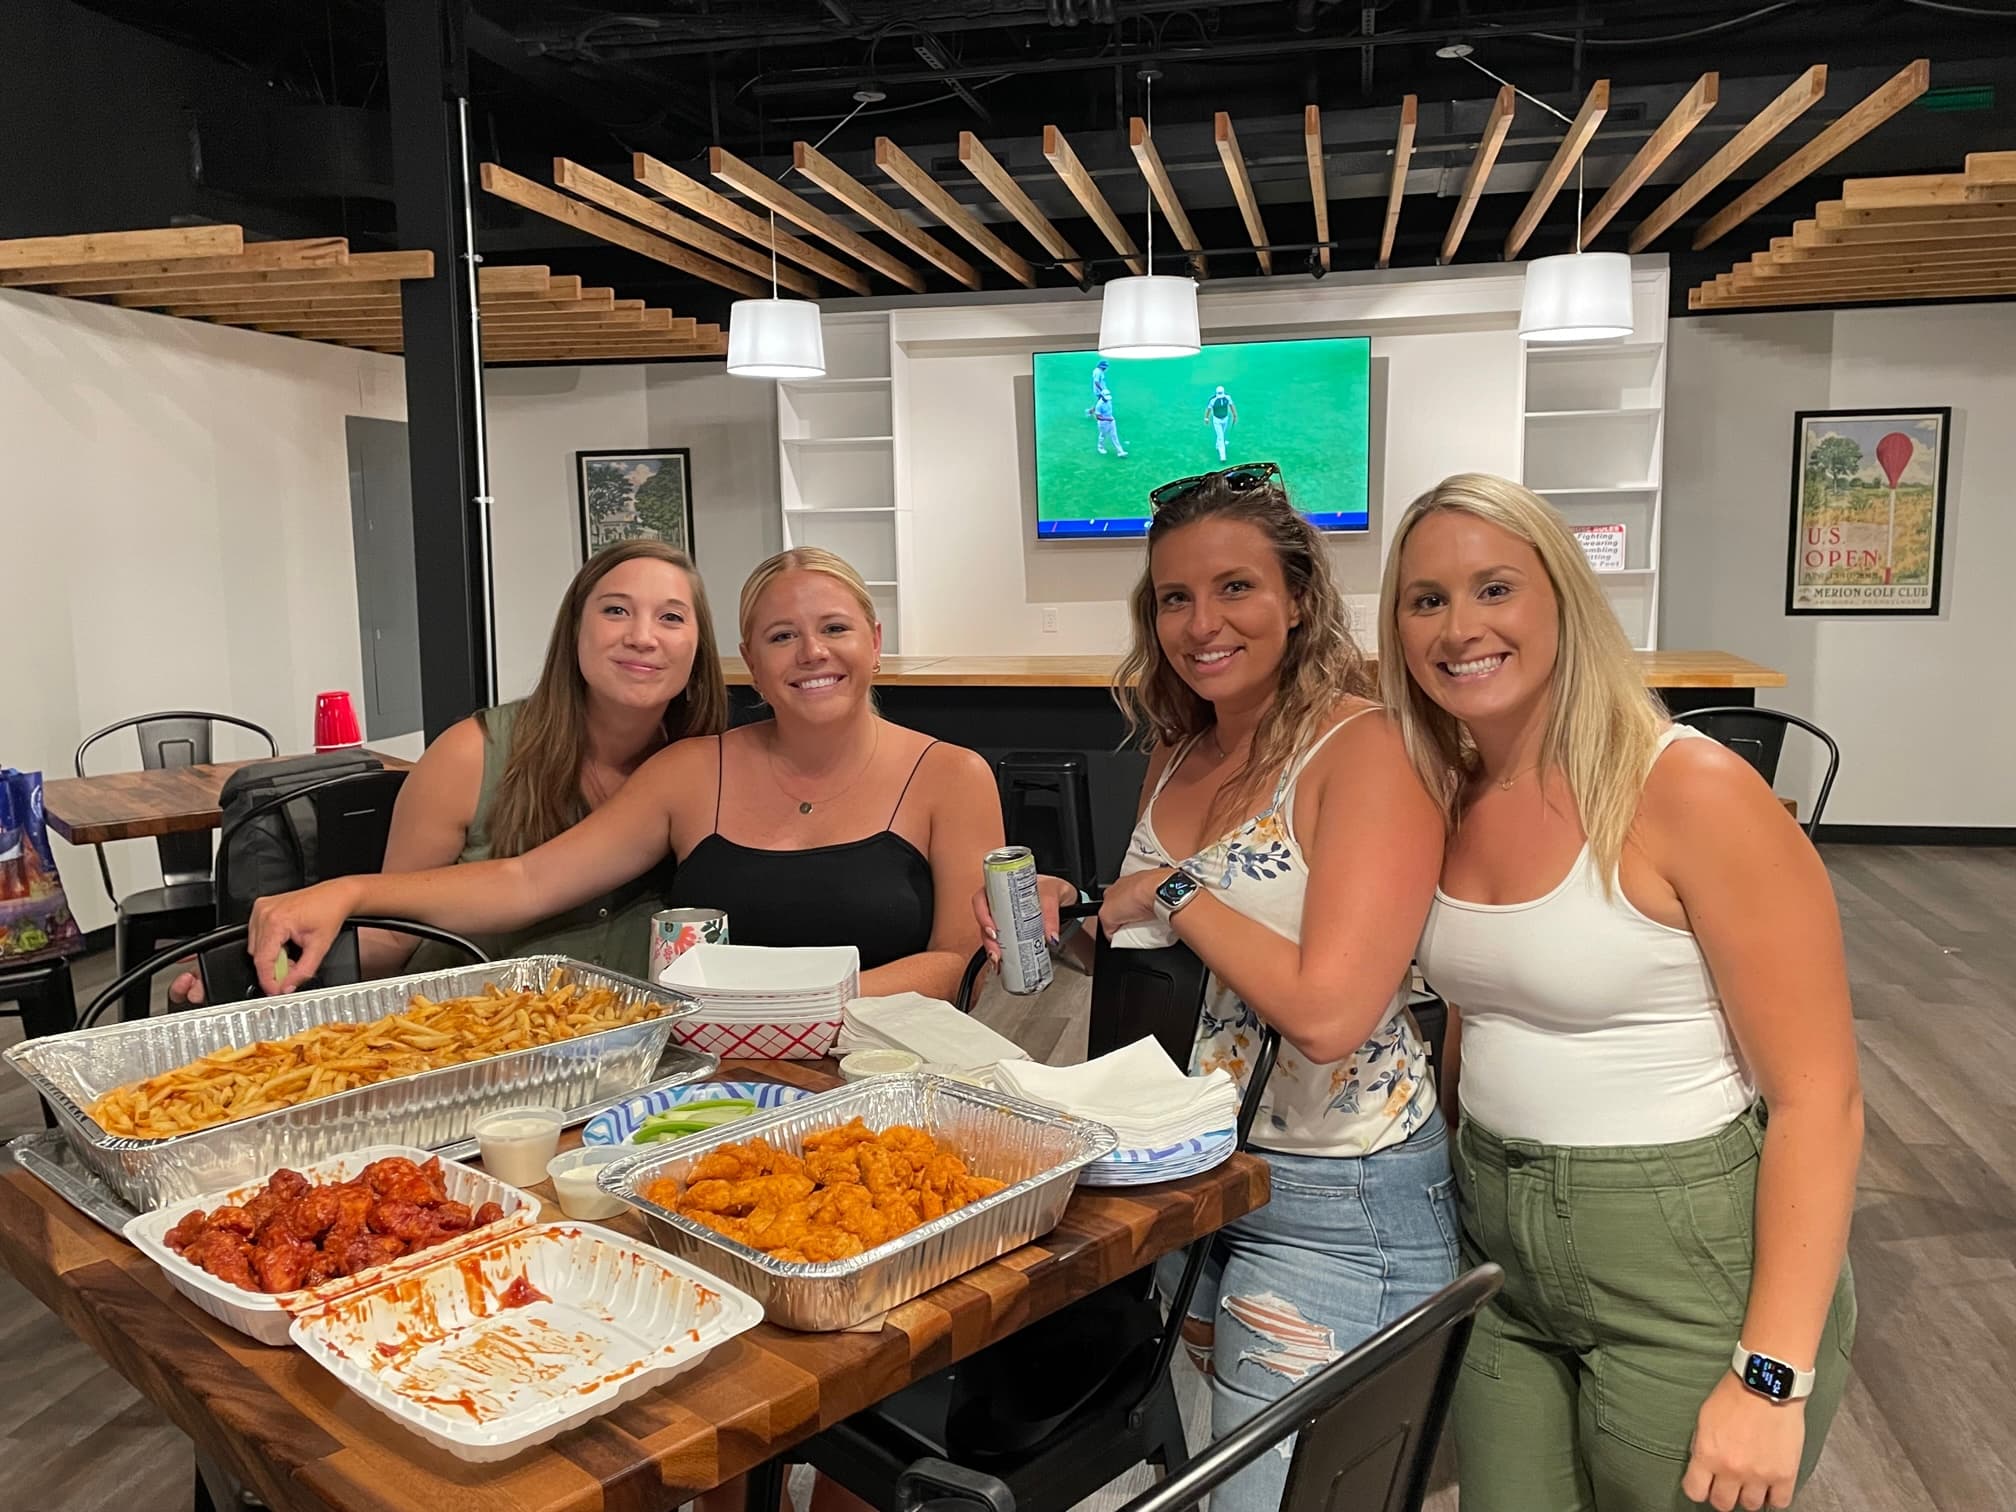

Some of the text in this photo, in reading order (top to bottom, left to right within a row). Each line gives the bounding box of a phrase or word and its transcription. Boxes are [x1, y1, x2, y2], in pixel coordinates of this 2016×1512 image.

[1808, 527, 1846, 545] U.S.
[1805, 550, 1878, 567] OPEN
[1814, 586, 1928, 598] MERION GOLF CLUB
